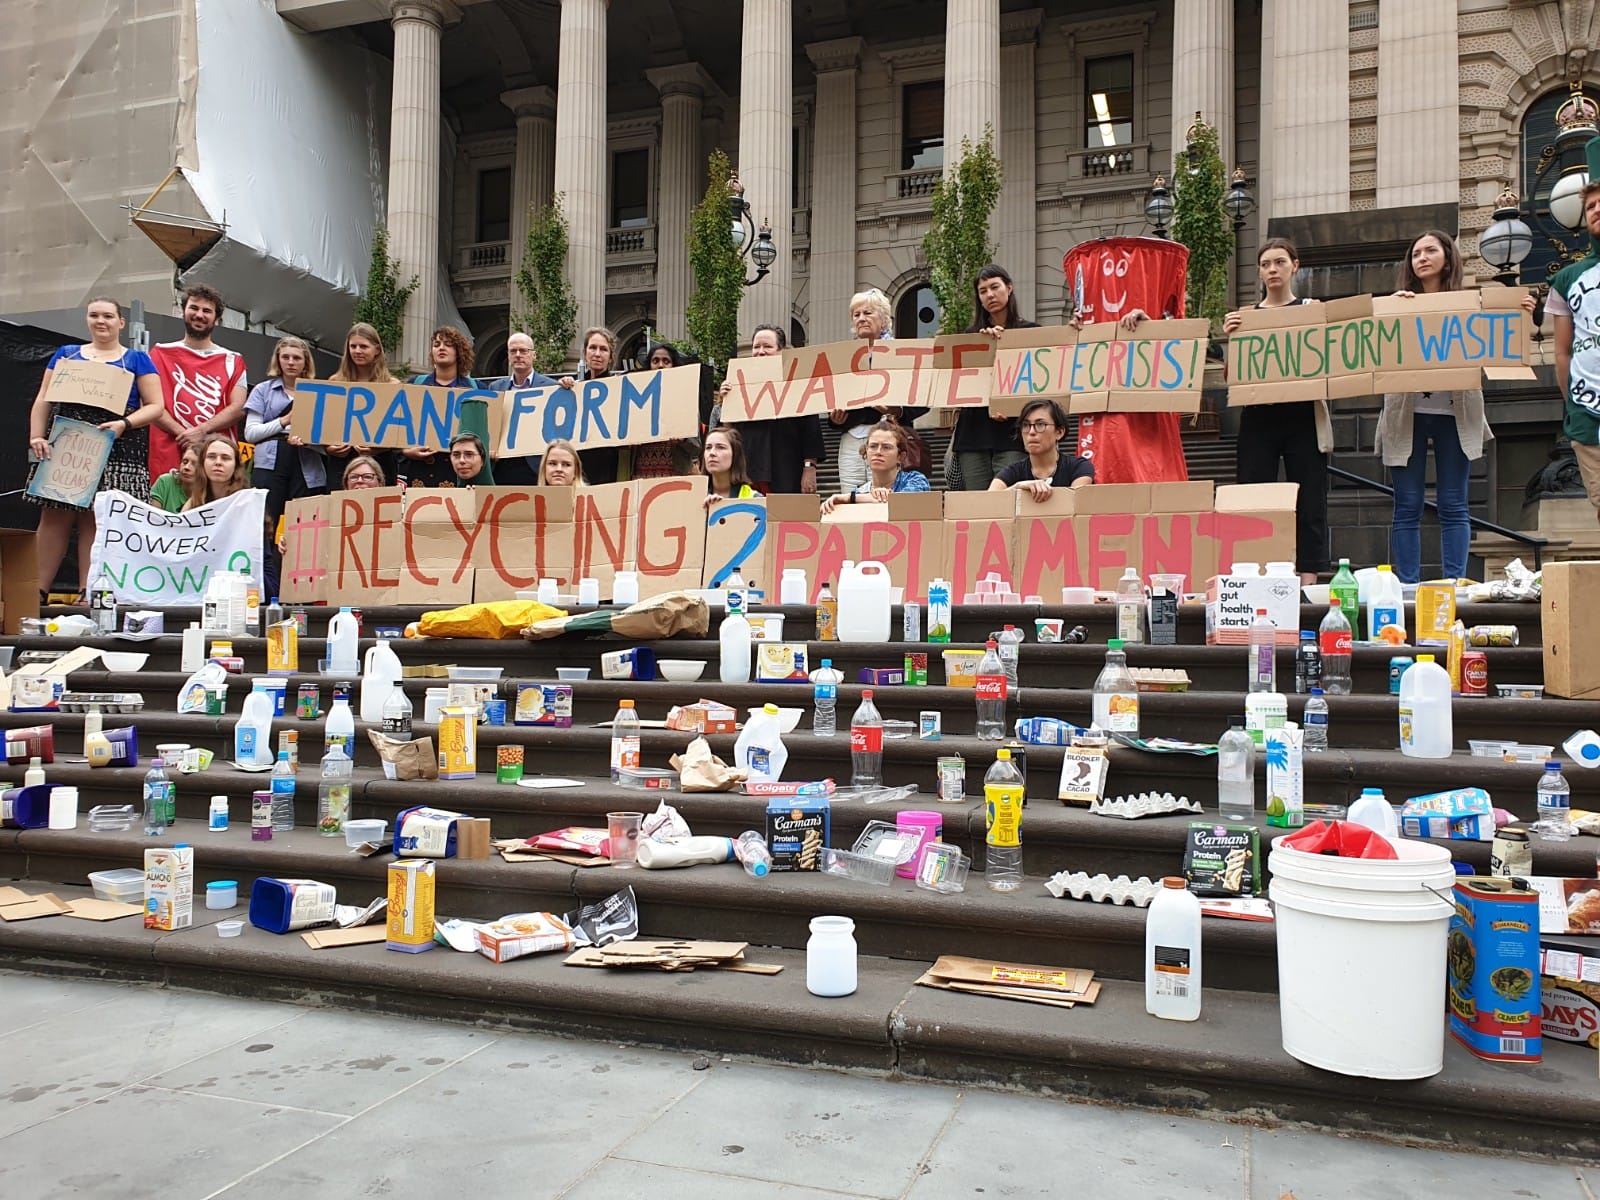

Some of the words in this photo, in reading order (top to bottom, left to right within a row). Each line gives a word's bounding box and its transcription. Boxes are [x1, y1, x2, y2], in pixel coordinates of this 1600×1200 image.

[1231, 318, 1402, 381] TRANSFORM
[1416, 312, 1521, 362] WASTE
[737, 344, 990, 420] WASTE
[60, 452, 91, 472] OUR
[52, 468, 90, 490] OCEANS
[109, 499, 216, 528] PEOPLE
[104, 529, 216, 555] POWER.
[706, 504, 766, 599] 2
[102, 561, 209, 593] NOW
[1220, 578, 1247, 589] Your
[1220, 592, 1239, 602] gut
[1220, 603, 1253, 613] health
[1220, 617, 1249, 626] starts
[755, 784, 796, 793] Colgate
[1066, 785, 1091, 793] CACAO
[774, 814, 822, 831] Carman's
[773, 835, 799, 843] Protein
[1194, 831, 1249, 846] Carman's
[1193, 850, 1222, 860] Protein
[146, 873, 172, 883] ALMOND
[1497, 1014, 1516, 1022] OLIVE
